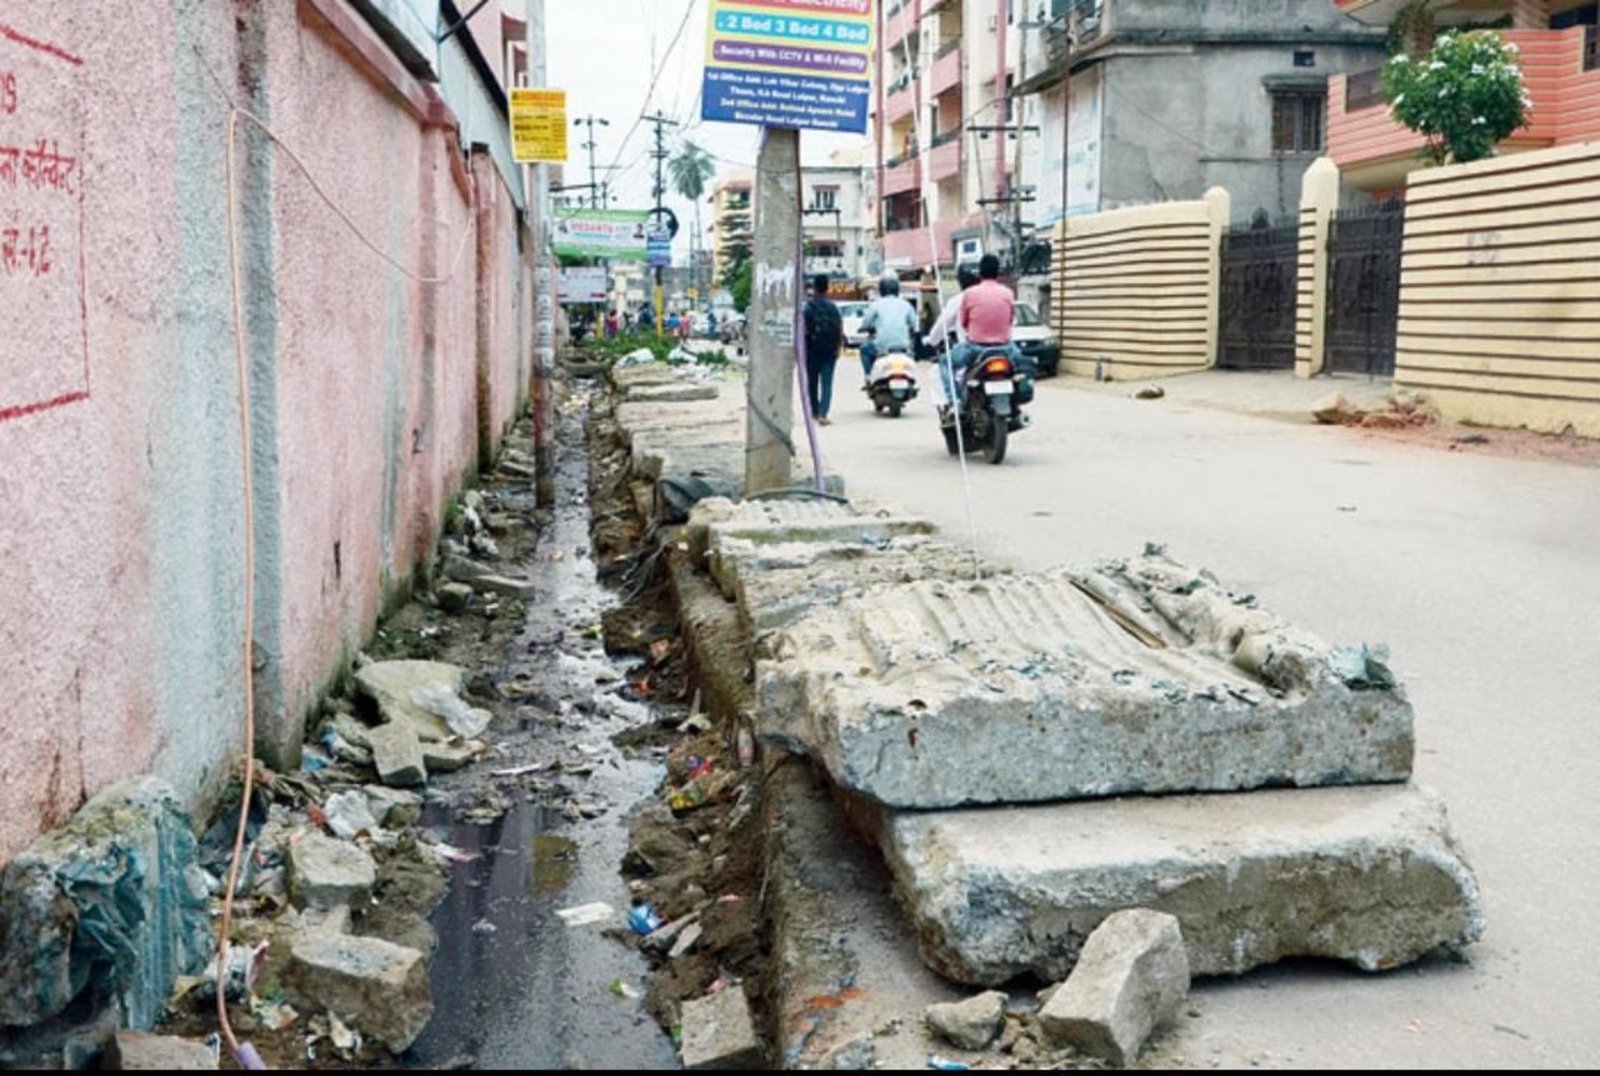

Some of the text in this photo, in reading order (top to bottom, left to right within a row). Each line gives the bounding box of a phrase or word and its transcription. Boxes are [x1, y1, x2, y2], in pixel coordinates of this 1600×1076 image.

[727, 15, 867, 41] 2 Bed 3 Bed 4 Bed
[719, 45, 756, 58] Security
[778, 50, 803, 61] CCTV
[833, 56, 866, 69] Facility
